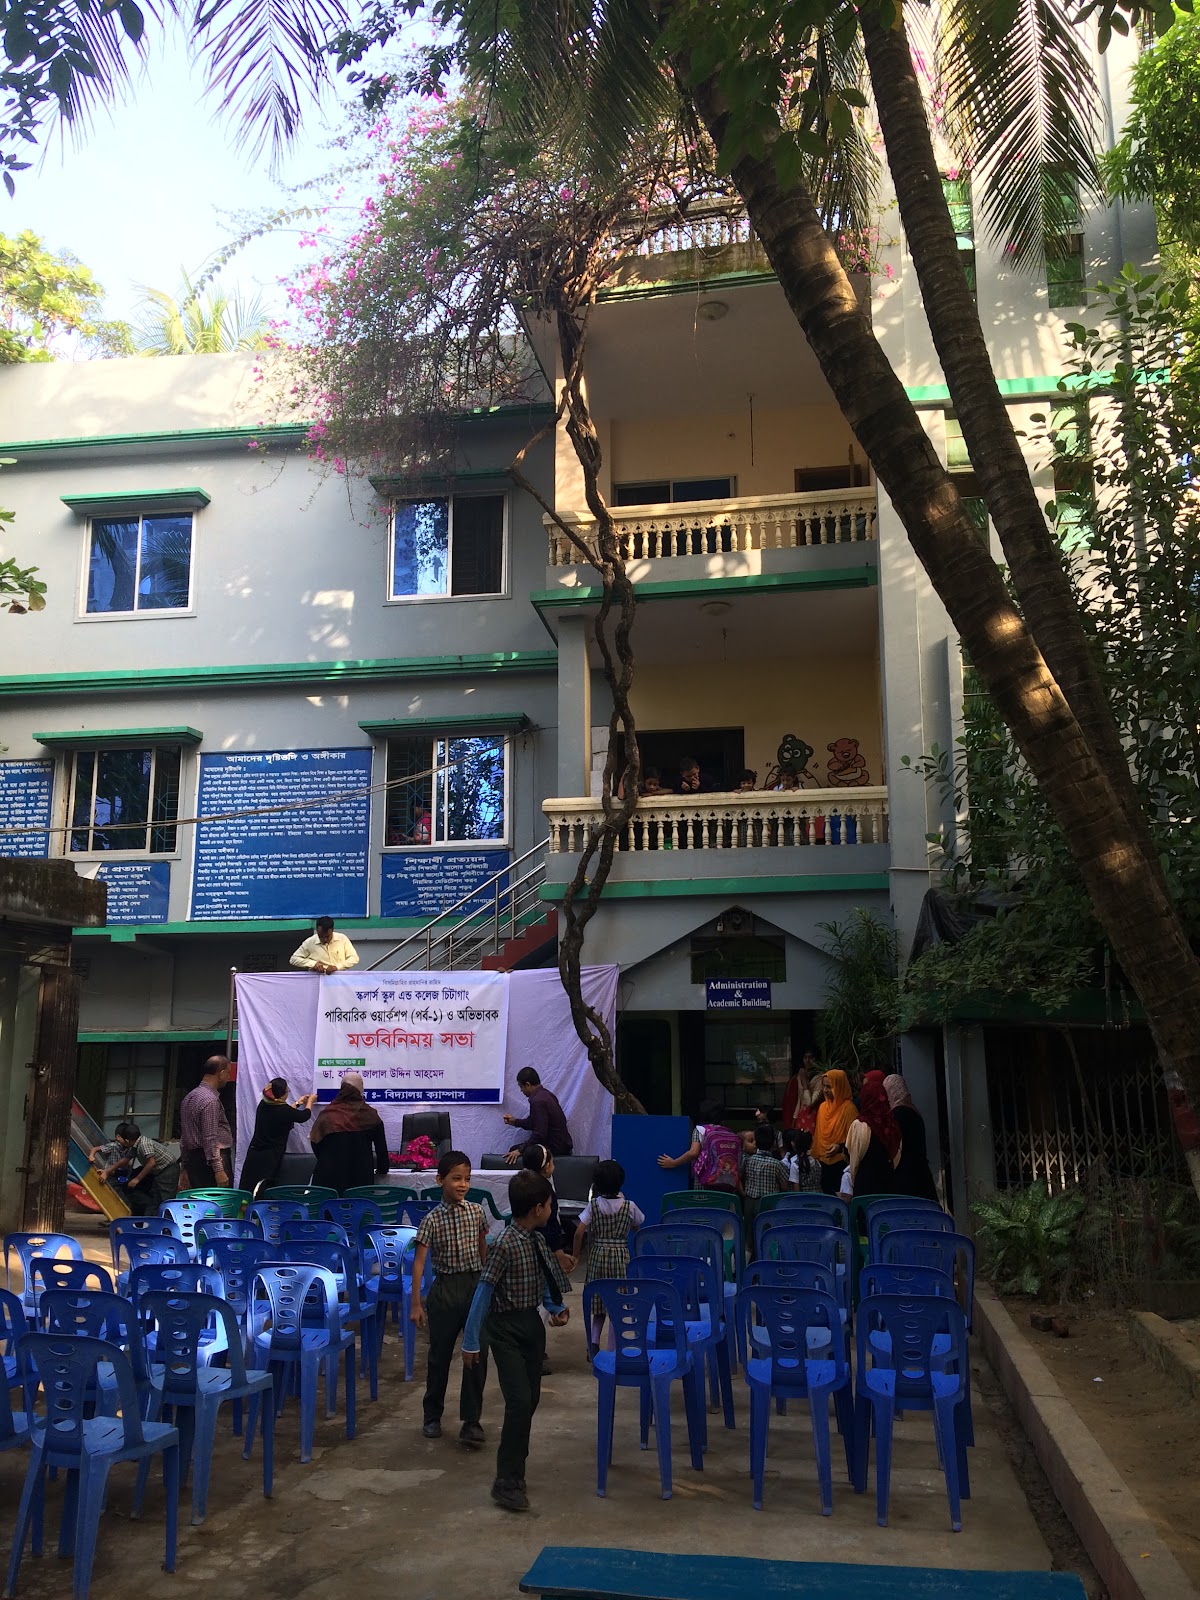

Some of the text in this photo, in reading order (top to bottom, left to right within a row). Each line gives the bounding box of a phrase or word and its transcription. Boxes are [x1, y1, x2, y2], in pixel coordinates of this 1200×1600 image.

[226, 755, 262, 763] আমাদের
[311, 752, 346, 760] অঙ্গীকার
[405, 856, 444, 864] শিক্ষার্থী
[709, 981, 768, 989] Administration
[355, 987, 470, 1006] স্কলার্স স্কুল এন্ড কলেজ চিটাগাং
[734, 990, 742, 998] &
[708, 999, 770, 1008] Academic Building
[325, 1006, 499, 1025] পারিবারিক ওয়ার্কশপ (পর্ব-১) ও অভিভাবক
[346, 1028, 475, 1050] মতবিনিময় সভা
[323, 1070, 334, 1079] ডা.
[362, 1069, 387, 1079] জালাল
[390, 1067, 411, 1079] উদ্দিন
[414, 1068, 444, 1079] আহমেদ
[385, 1088, 423, 1100] বিদ্যালয়
[426, 1090, 465, 1100] ক্যাম্পাস
